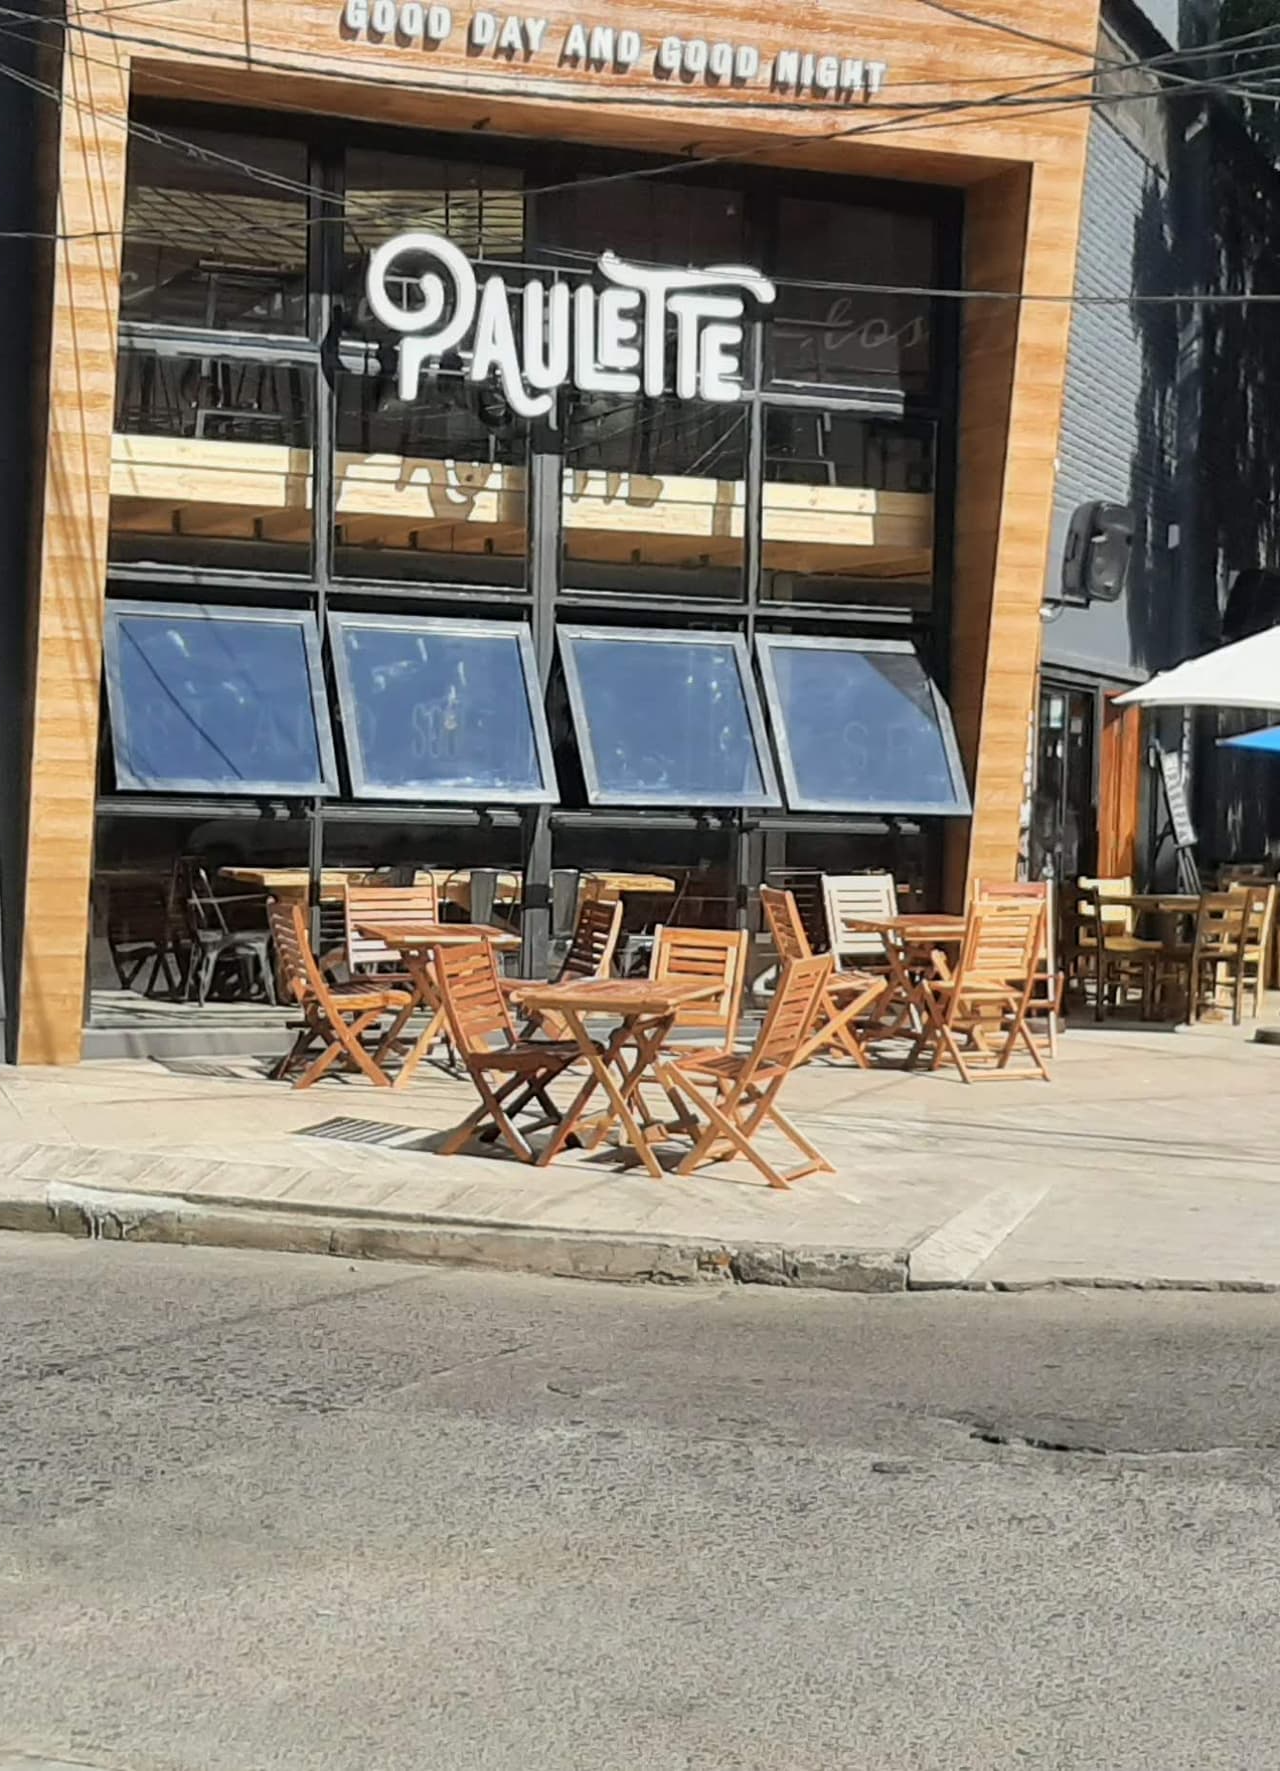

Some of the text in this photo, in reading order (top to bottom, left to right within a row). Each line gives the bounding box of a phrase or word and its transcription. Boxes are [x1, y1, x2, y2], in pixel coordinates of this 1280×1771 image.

[343, 0, 887, 96] GOOD DAY AND GOOD NIGHT
